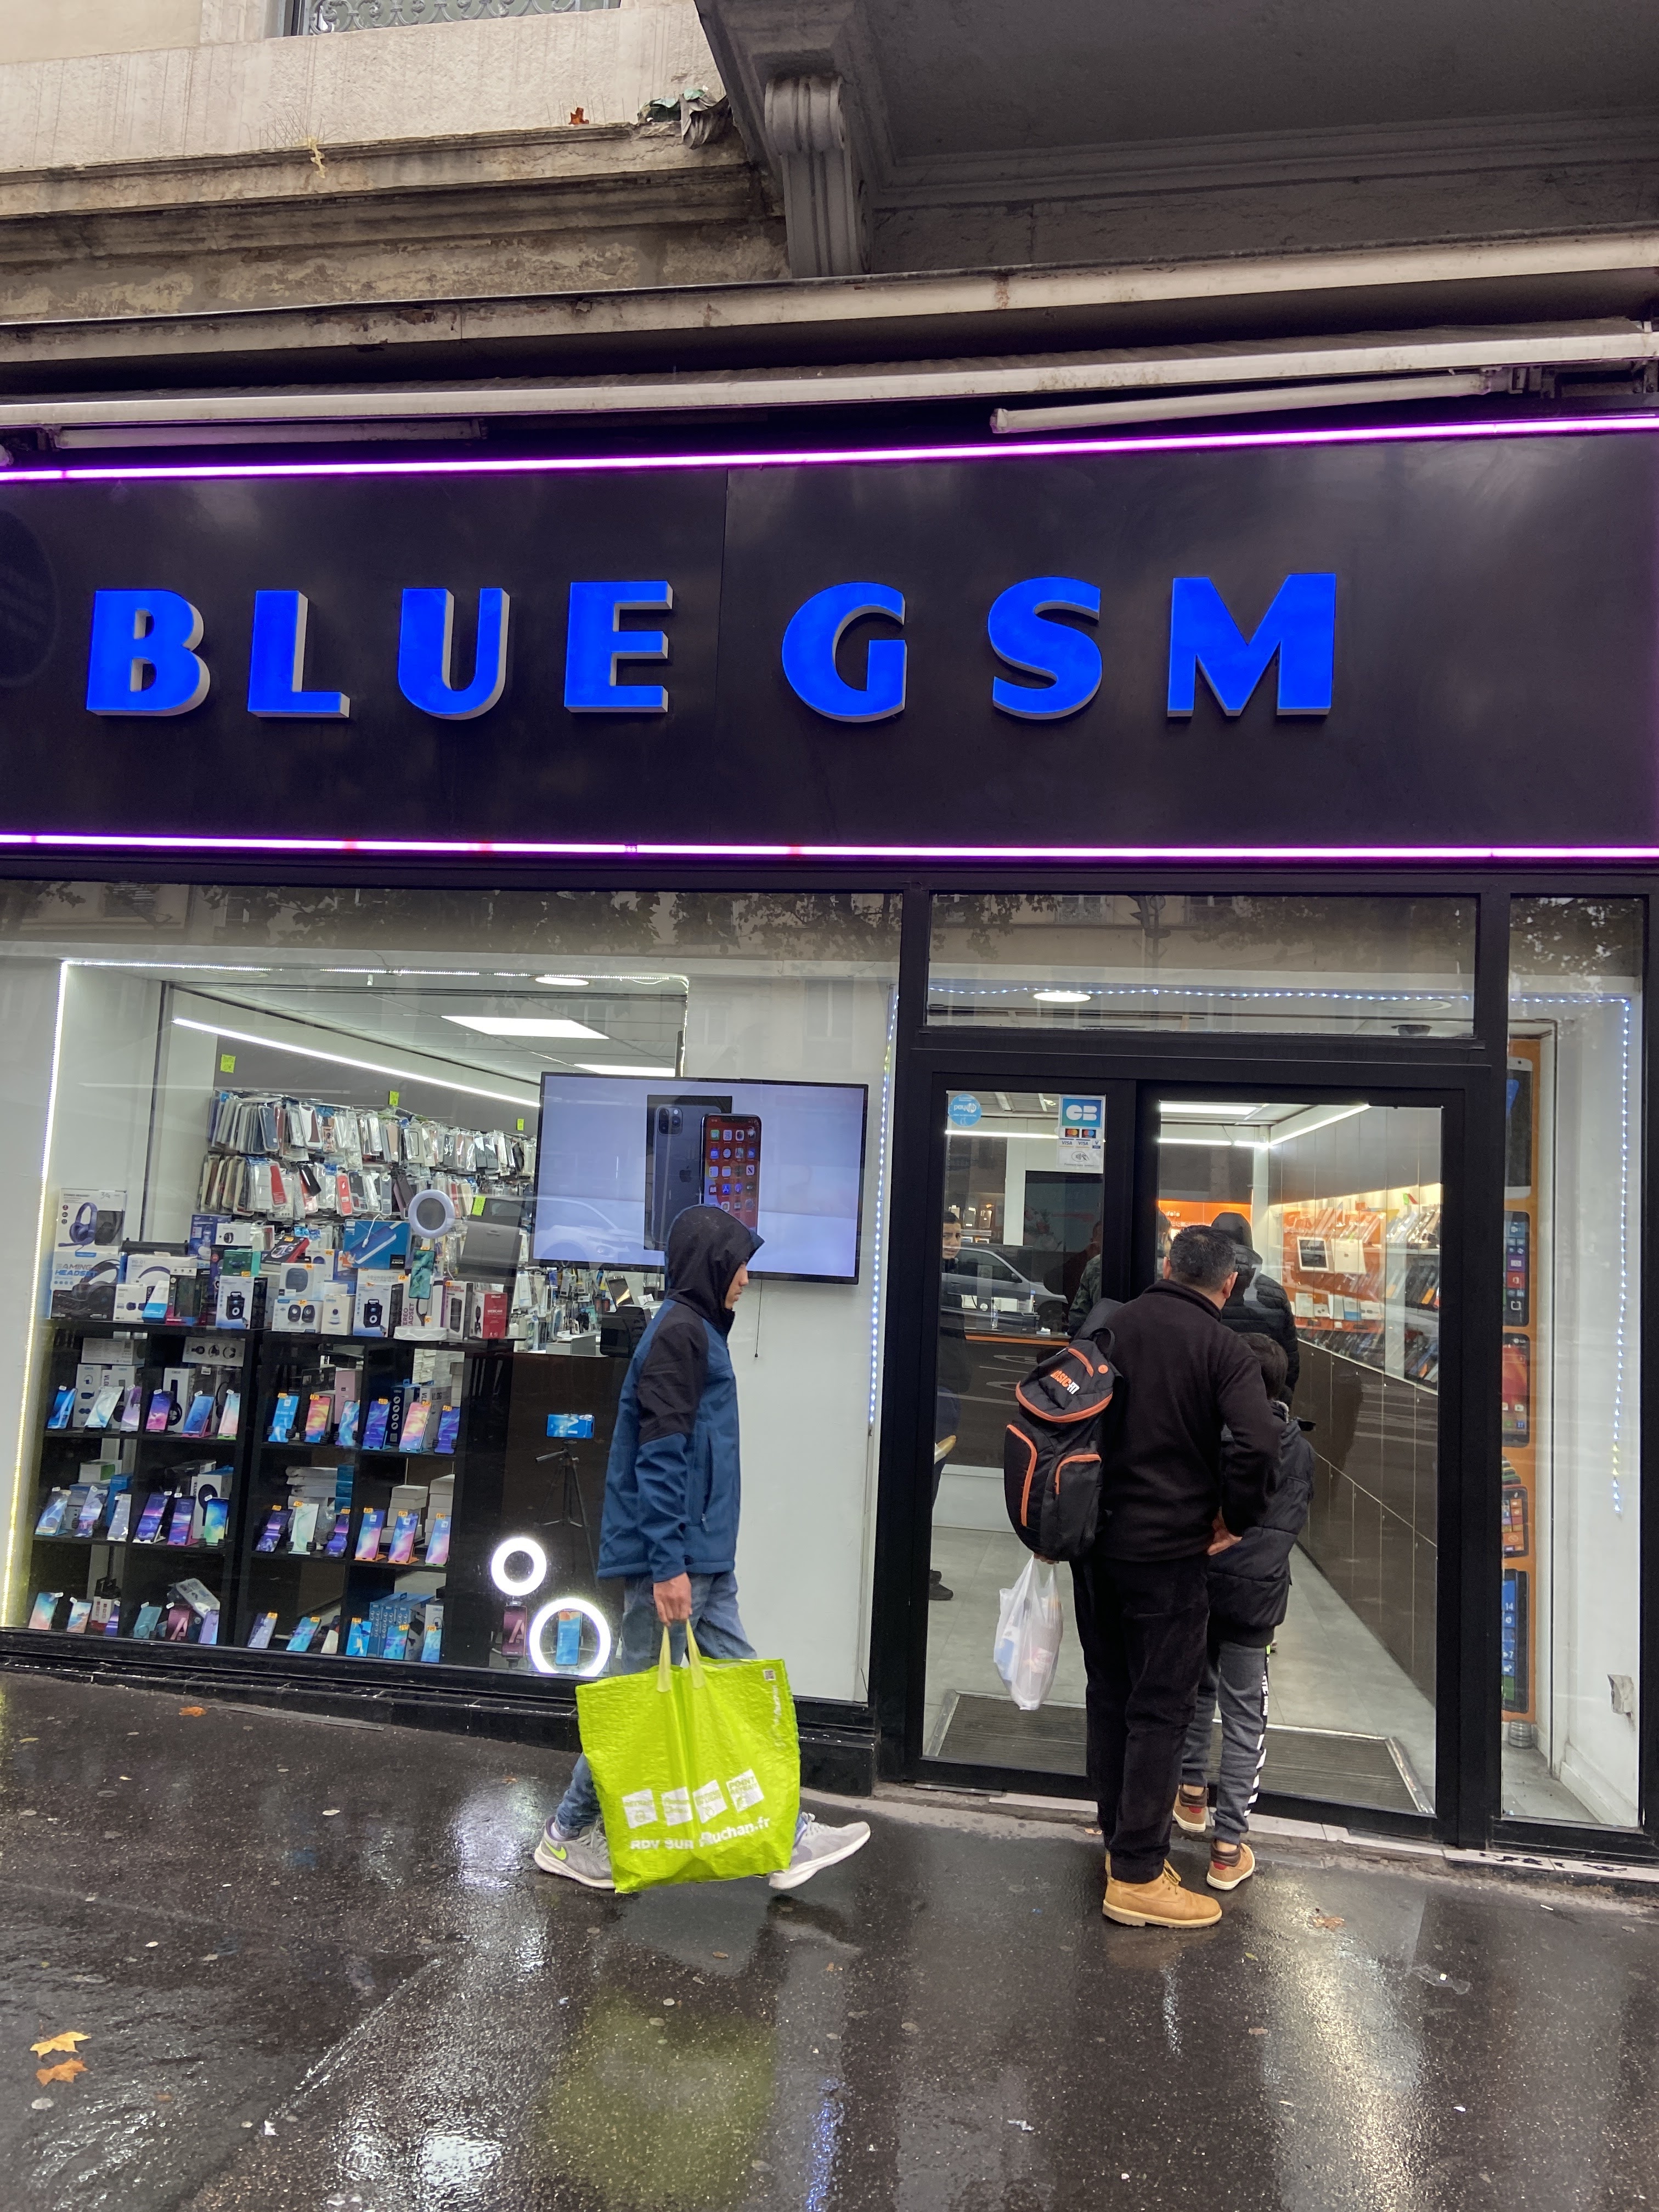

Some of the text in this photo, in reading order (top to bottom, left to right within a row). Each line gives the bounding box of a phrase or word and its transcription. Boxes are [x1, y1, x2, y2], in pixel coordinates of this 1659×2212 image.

[86, 573, 1336, 723] BLUE GSM
[1505, 1602, 1514, 1611] 14
[630, 1816, 770, 1850] RDV SUR Auchan.fr
